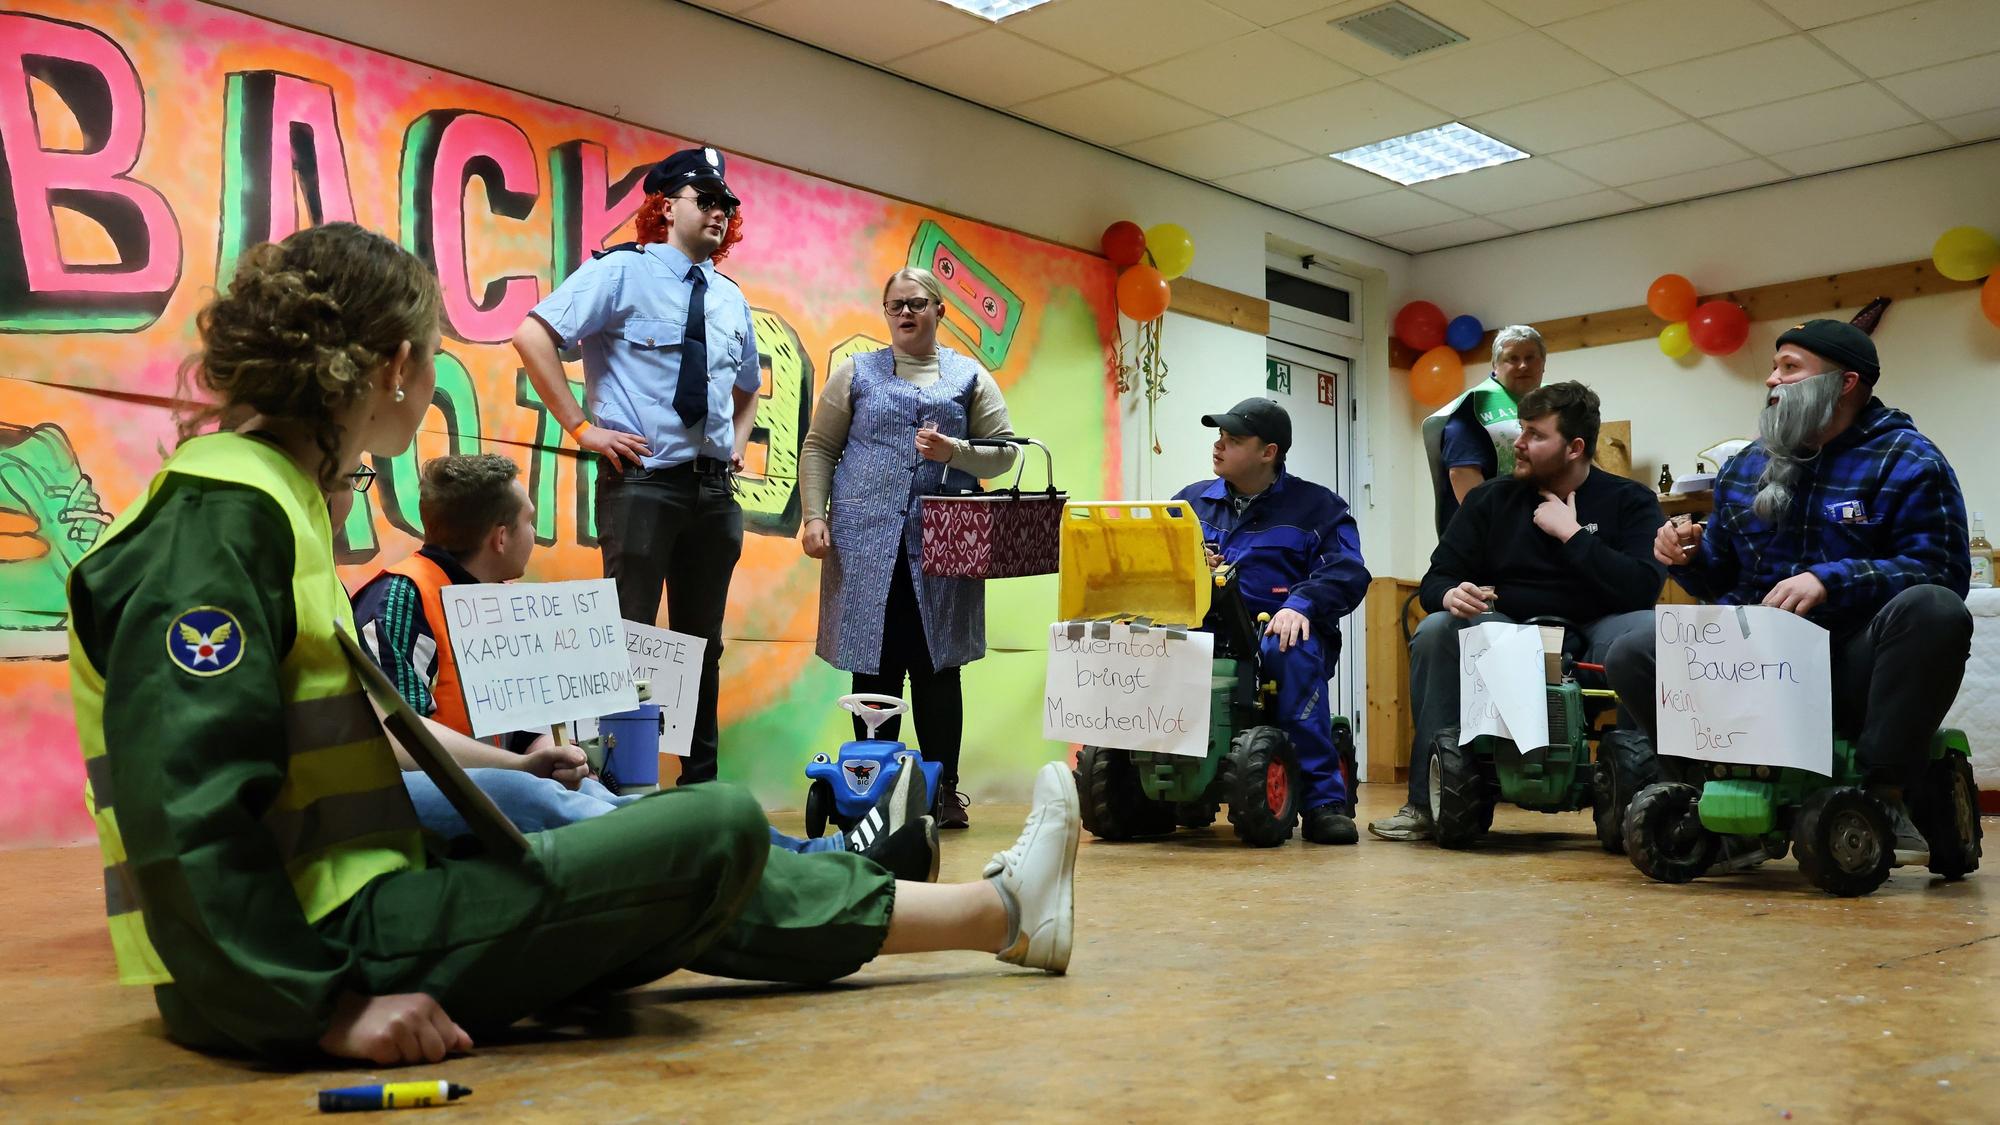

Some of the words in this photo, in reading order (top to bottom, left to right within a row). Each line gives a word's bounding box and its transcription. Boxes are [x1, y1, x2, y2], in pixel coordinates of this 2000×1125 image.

[0, 11, 650, 361] BACK
[510, 595, 564, 622] ERDE
[572, 590, 600, 616] IST
[460, 633, 544, 665] KAPUTA
[554, 627, 582, 651] ALS
[588, 624, 616, 648] DIE
[1052, 624, 1171, 658] Bauerntod
[1075, 659, 1150, 695] bringt
[1684, 646, 1800, 685] Bauern
[473, 674, 555, 714] HÜFFTE
[1691, 717, 1749, 751] Bier
